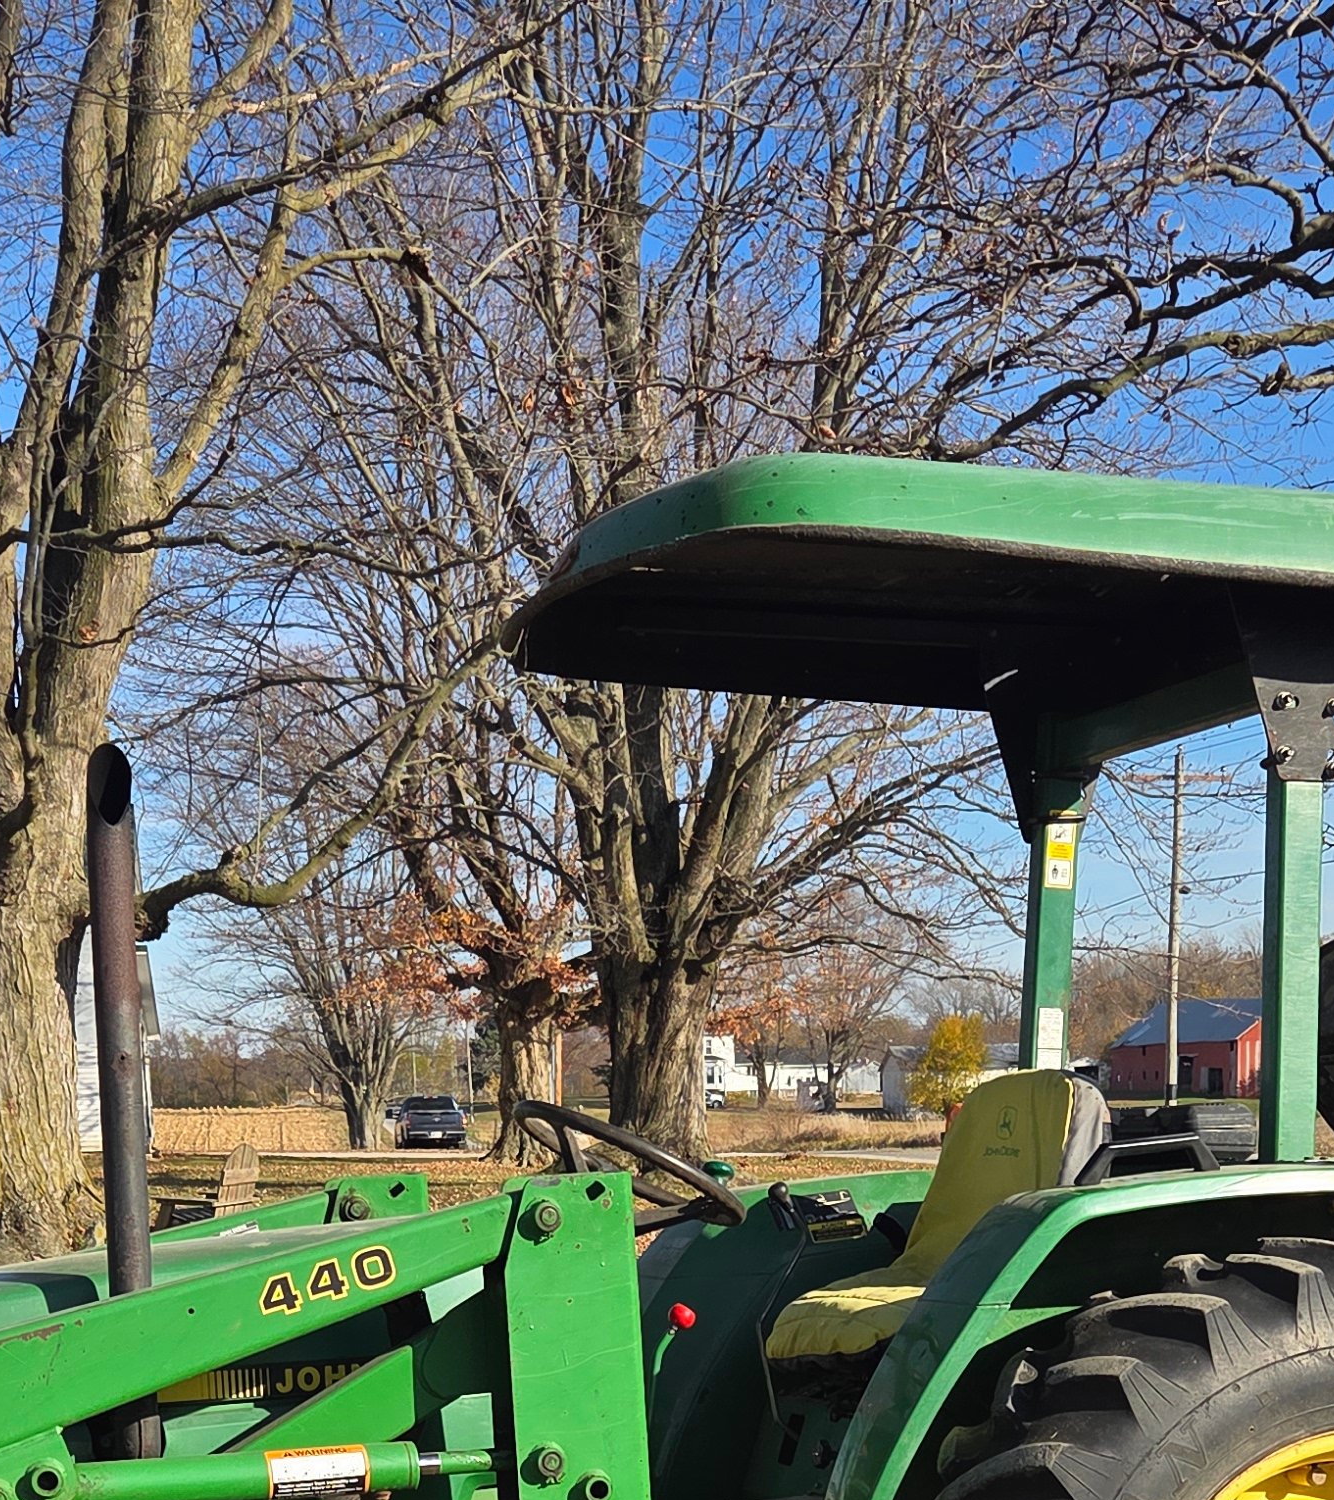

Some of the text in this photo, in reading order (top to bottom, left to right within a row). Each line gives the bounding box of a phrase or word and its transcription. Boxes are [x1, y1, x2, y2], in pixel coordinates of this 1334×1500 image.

[259, 1245, 396, 1315] 440
[275, 1363, 362, 1394] JOH
[293, 1447, 347, 1457] WARNING
